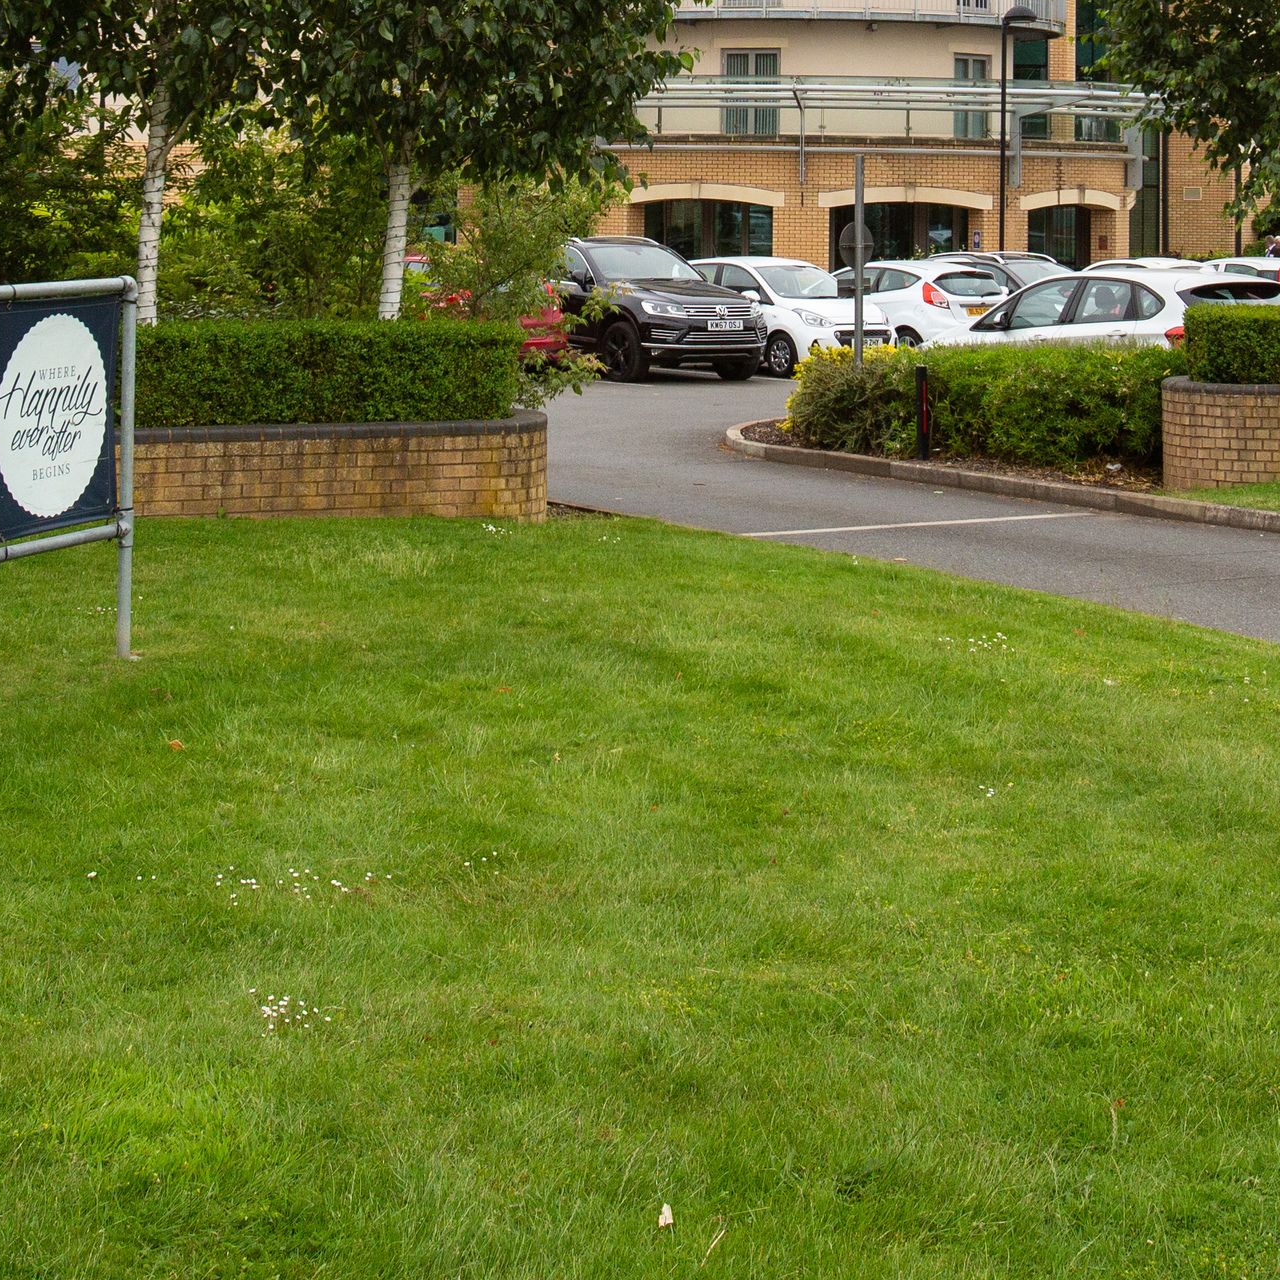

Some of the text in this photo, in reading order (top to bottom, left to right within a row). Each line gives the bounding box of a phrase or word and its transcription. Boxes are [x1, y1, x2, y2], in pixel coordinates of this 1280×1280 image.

[39, 365, 77, 380] WHERE
[10, 418, 82, 461] ever after
[32, 462, 71, 481] BEGINS
